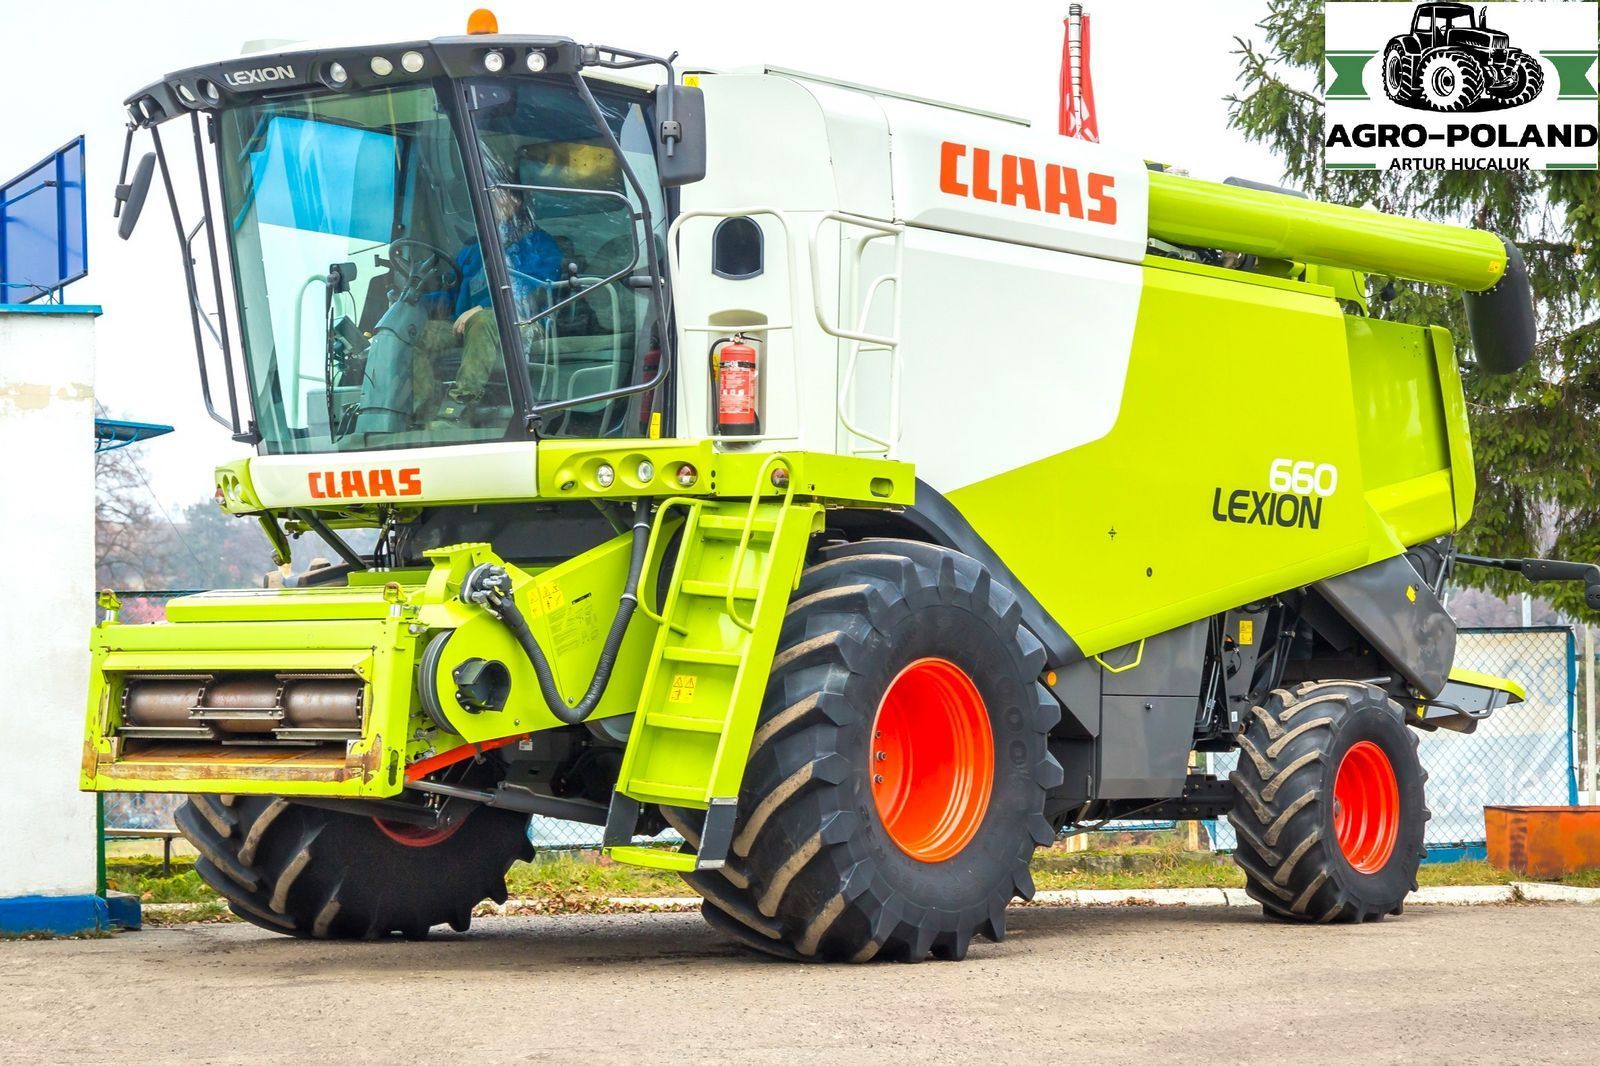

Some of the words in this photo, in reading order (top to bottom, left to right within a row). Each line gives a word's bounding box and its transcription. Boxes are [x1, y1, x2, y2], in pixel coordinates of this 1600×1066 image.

[224, 65, 296, 86] LEXION
[939, 140, 1117, 226] CLAAS
[308, 467, 422, 499] CLAAS
[1269, 458, 1338, 497] 660
[1212, 487, 1323, 530] LEXION
